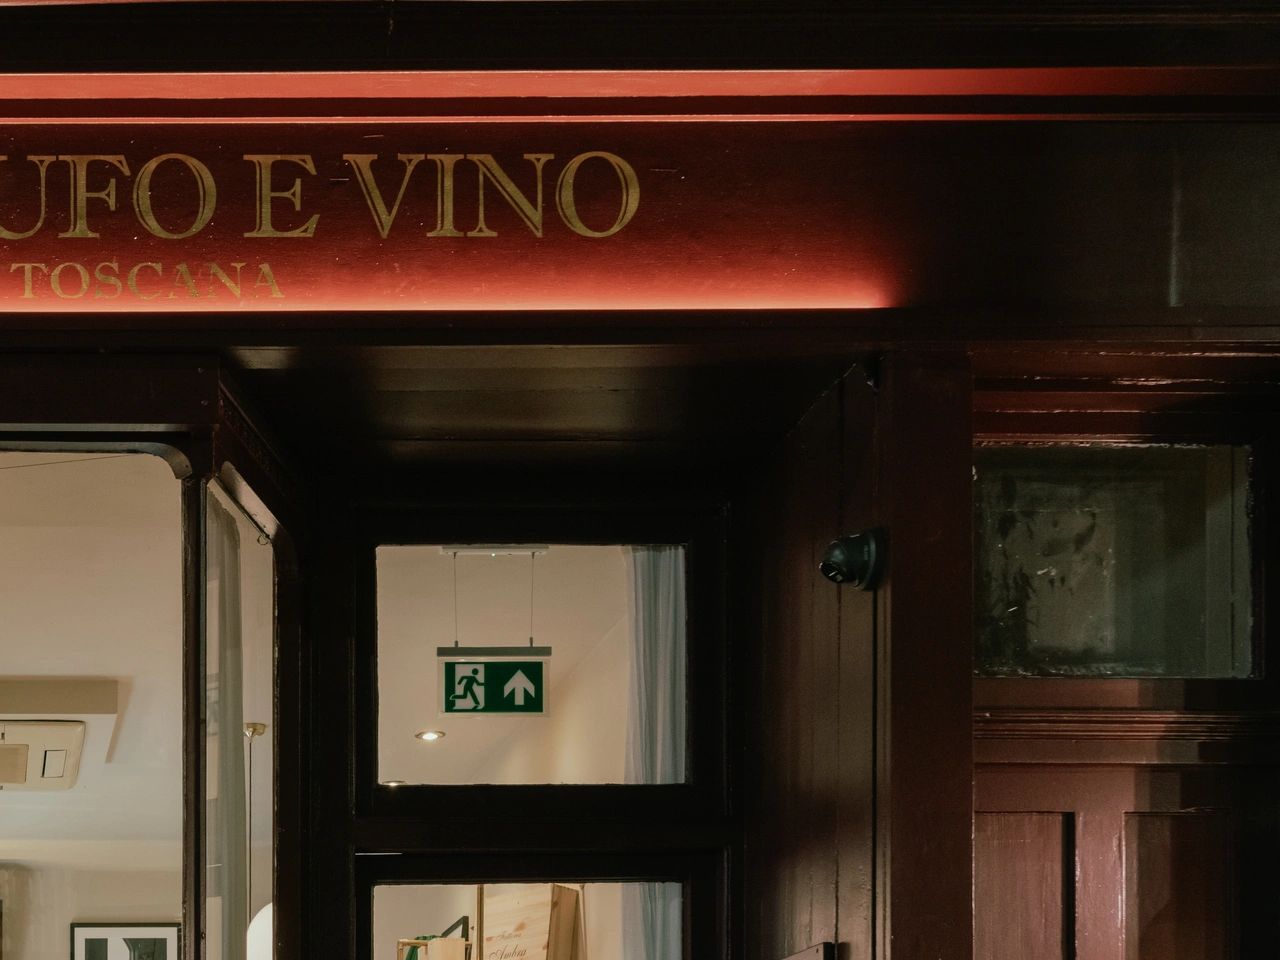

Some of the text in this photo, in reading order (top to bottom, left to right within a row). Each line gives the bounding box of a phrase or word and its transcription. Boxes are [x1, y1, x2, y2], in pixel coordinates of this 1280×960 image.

[242, 153, 320, 239] E
[345, 151, 640, 239] VINO
[10, 261, 286, 301] TOSCANA
